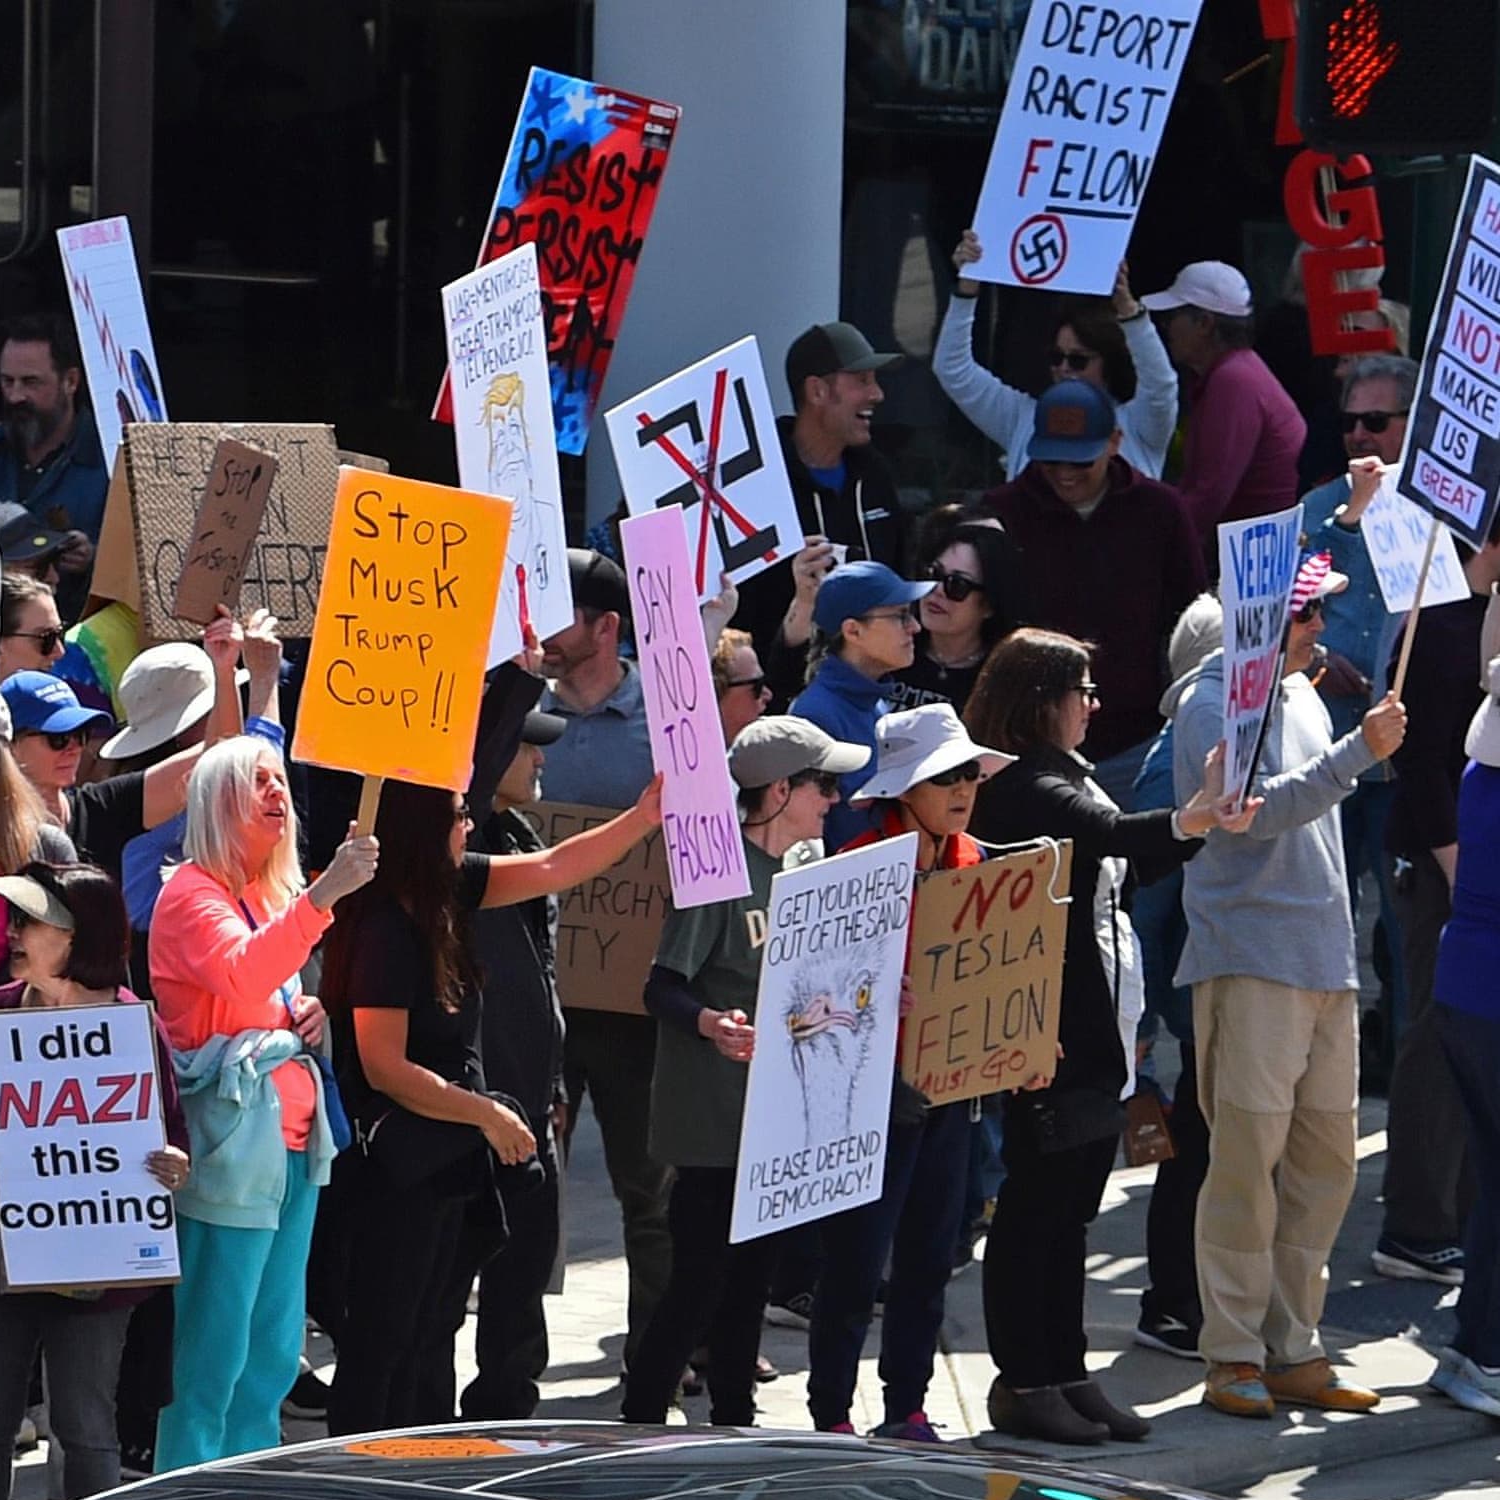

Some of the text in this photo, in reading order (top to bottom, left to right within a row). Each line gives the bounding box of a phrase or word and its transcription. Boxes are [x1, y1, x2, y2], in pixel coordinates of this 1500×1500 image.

[1041, 2, 1190, 71] DEPORT
[1023, 65, 1167, 131] RACIST
[1017, 139, 1151, 207] FELON
[1439, 365, 1495, 424] MAKE
[1441, 427, 1468, 460] US
[1419, 460, 1477, 514] GREAT
[353, 490, 468, 571] Stop
[637, 565, 678, 646] SAY
[653, 647, 698, 718] NO
[664, 718, 698, 777] TO
[664, 811, 743, 890] FASCISM
[777, 890, 815, 929] GET
[816, 881, 862, 915] YOUR
[864, 863, 909, 902] HEAD
[768, 931, 805, 966] OUT
[808, 923, 831, 952] OF
[831, 913, 866, 945] THE
[864, 897, 909, 940] SAND
[924, 925, 1044, 993] TESLA
[10, 1022, 112, 1062] I did
[916, 977, 1048, 1075] FELON
[914, 1049, 1026, 1098] MUST GO
[31, 1140, 120, 1177] this
[750, 1131, 881, 1192] PLEASE DEFEND
[0, 1190, 174, 1230] coming
[757, 1163, 873, 1222] DEMOCRACY!
